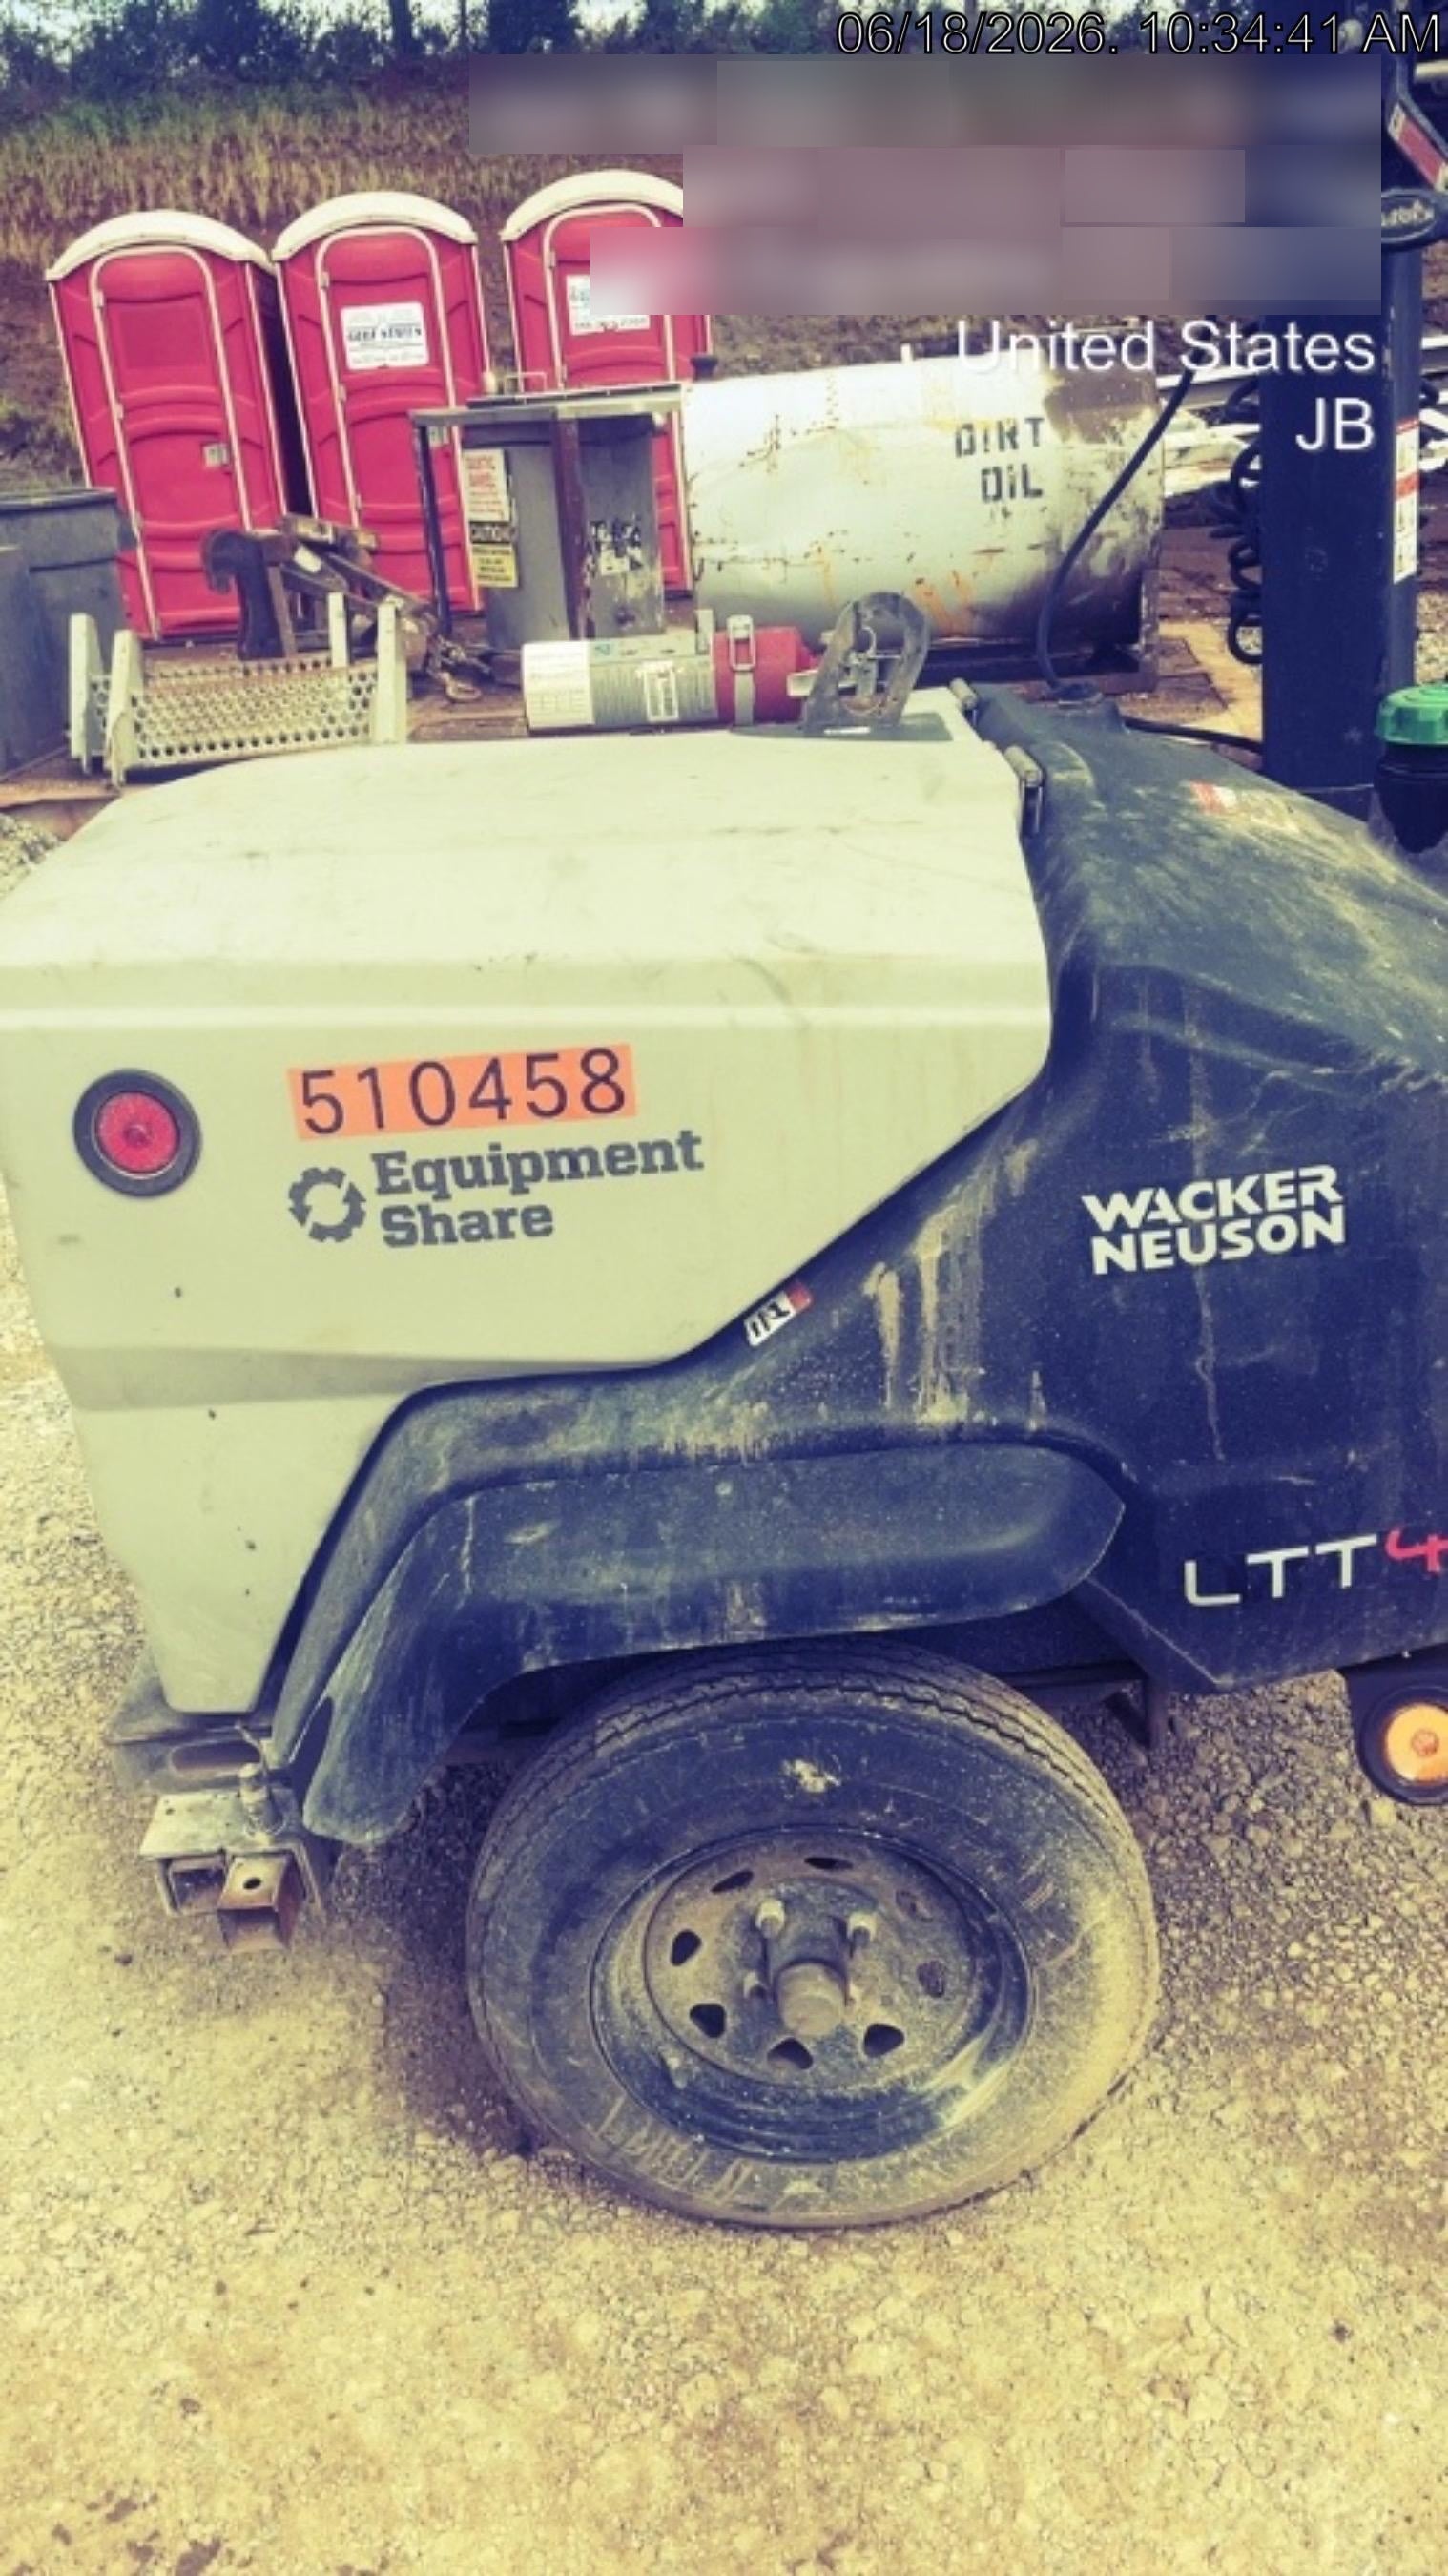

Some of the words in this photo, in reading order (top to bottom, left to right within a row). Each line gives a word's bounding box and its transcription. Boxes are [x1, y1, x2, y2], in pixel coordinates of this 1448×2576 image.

[955, 417, 1045, 458] DIRT
[301, 1047, 626, 1135] 510458
[371, 1130, 704, 1202] Equipment
[1081, 1164, 1343, 1233] WACKER
[381, 1204, 553, 1249] Share
[1091, 1204, 1346, 1275] NEUSON
